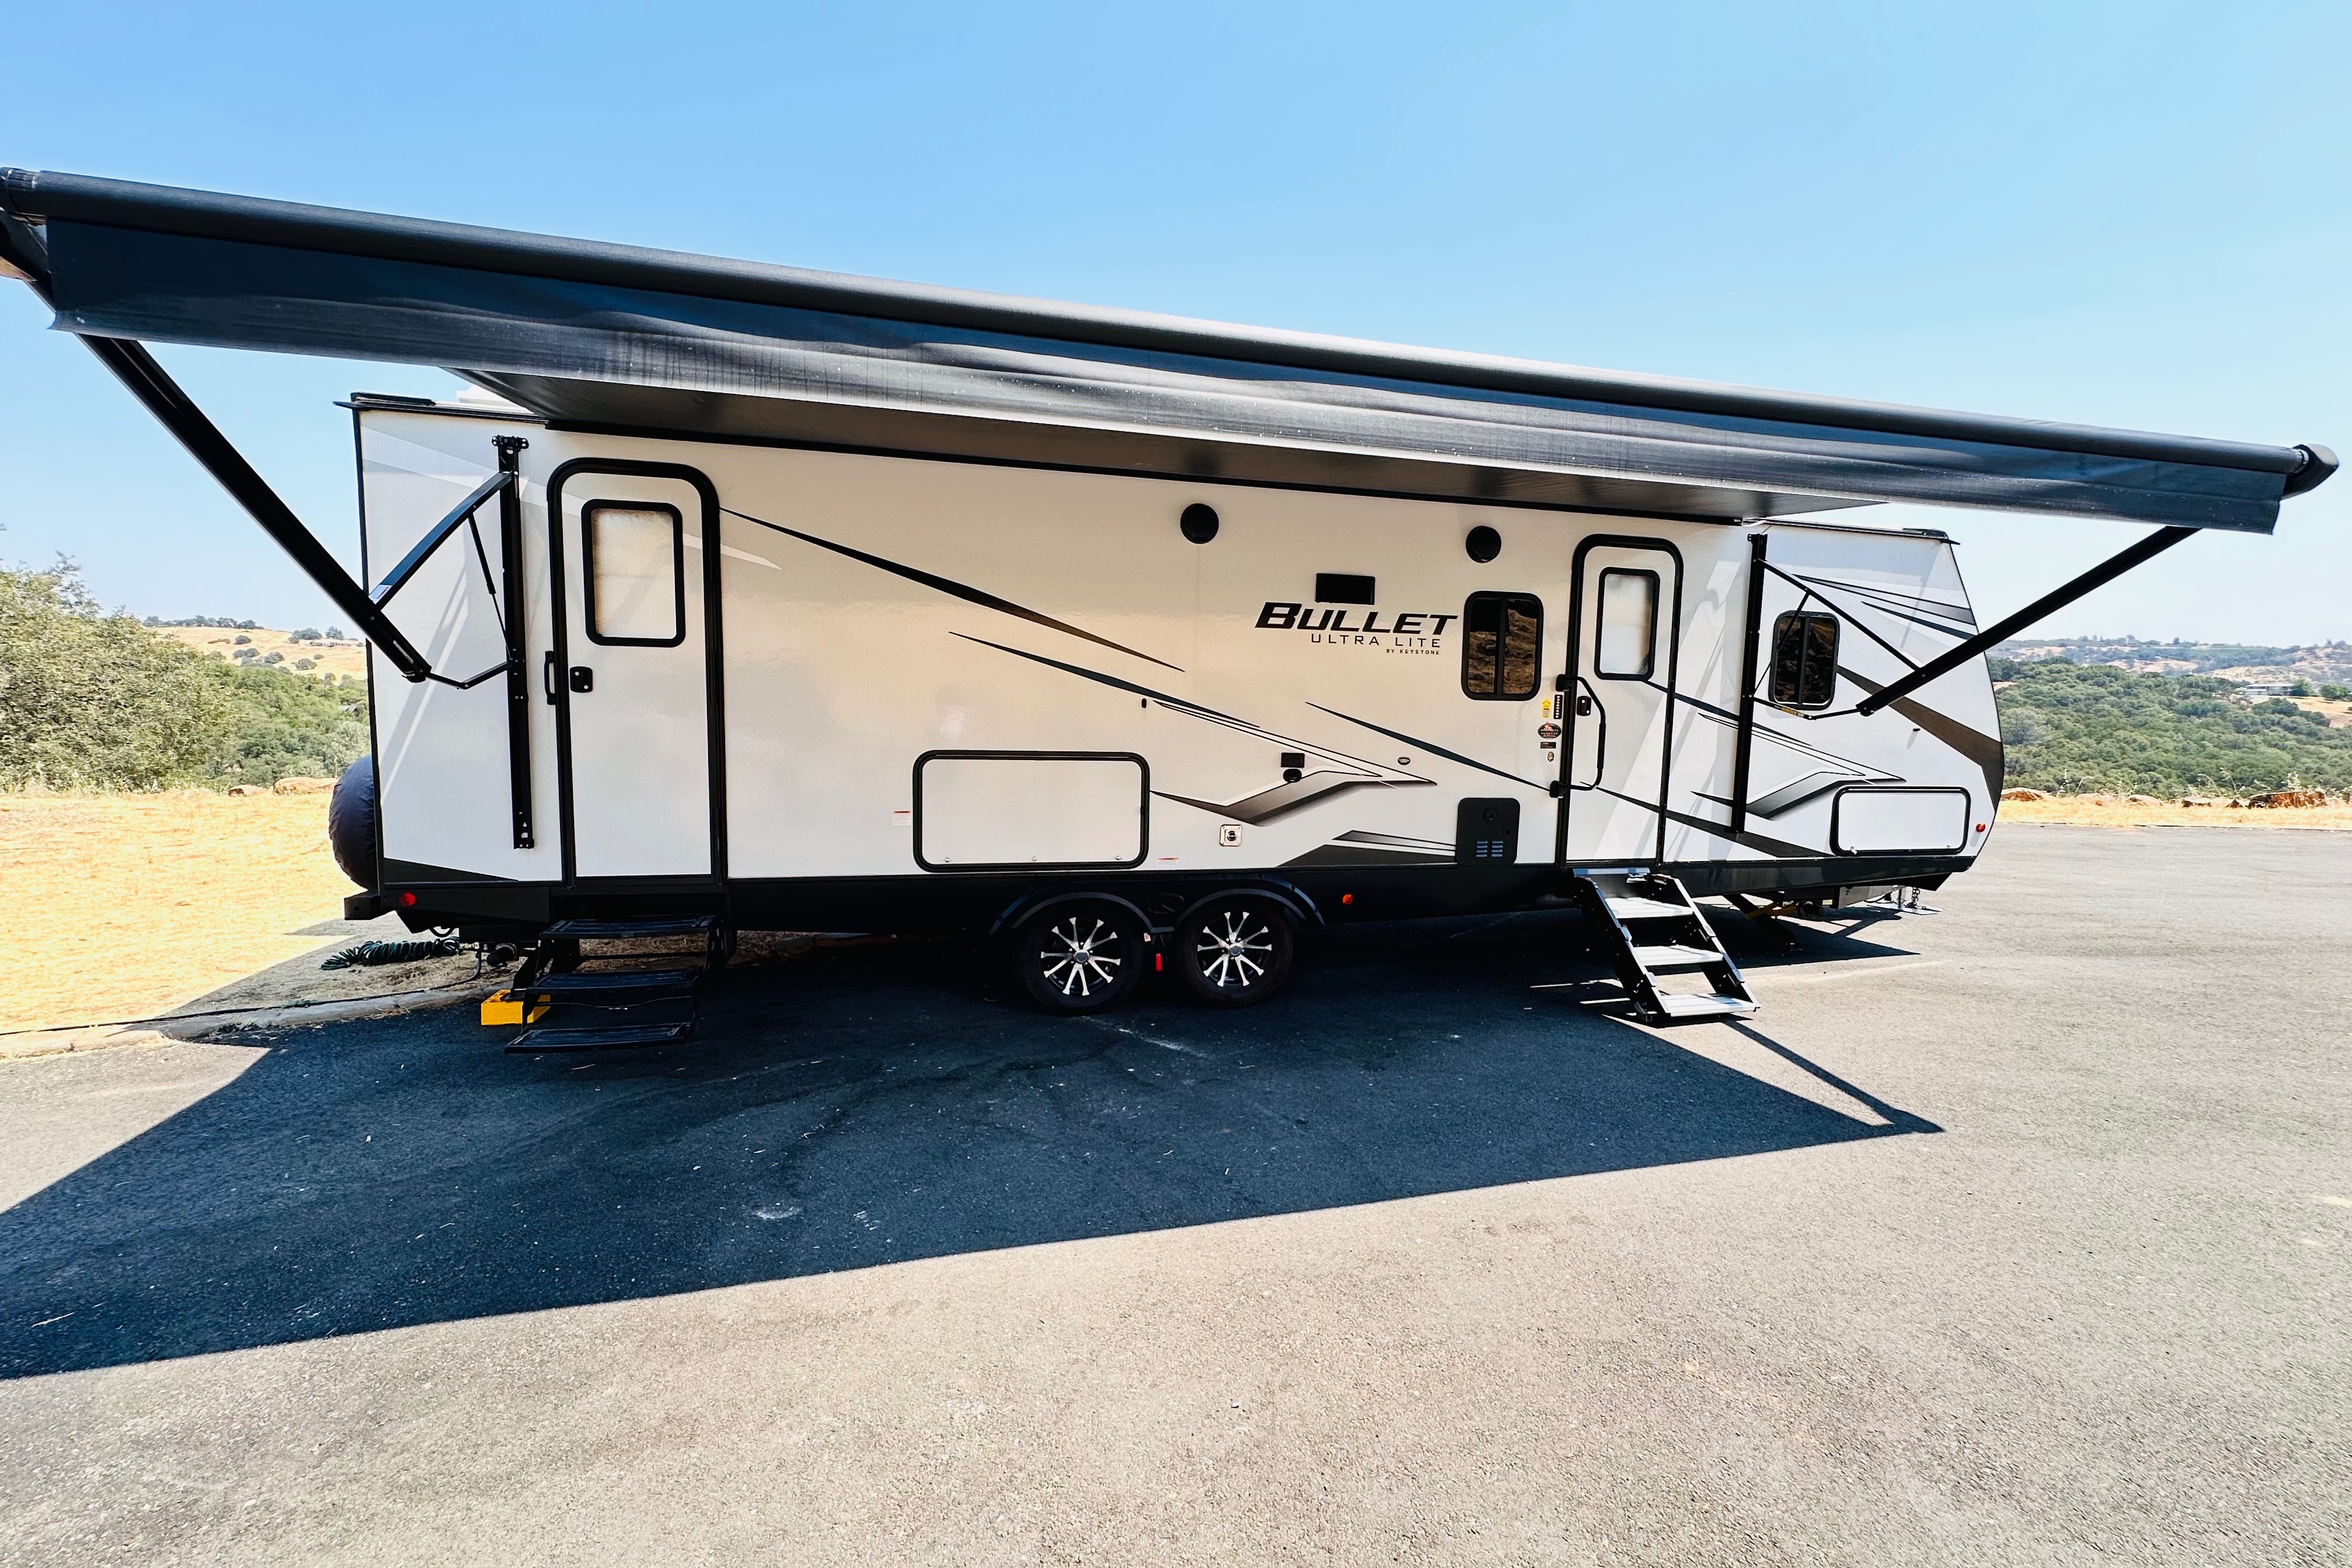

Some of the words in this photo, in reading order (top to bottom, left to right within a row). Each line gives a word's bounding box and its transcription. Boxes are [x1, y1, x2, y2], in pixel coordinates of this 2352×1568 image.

[1254, 601, 1459, 635] BULLET
[1311, 634, 1380, 646] ULTRA
[1395, 637, 1440, 648] LITE
